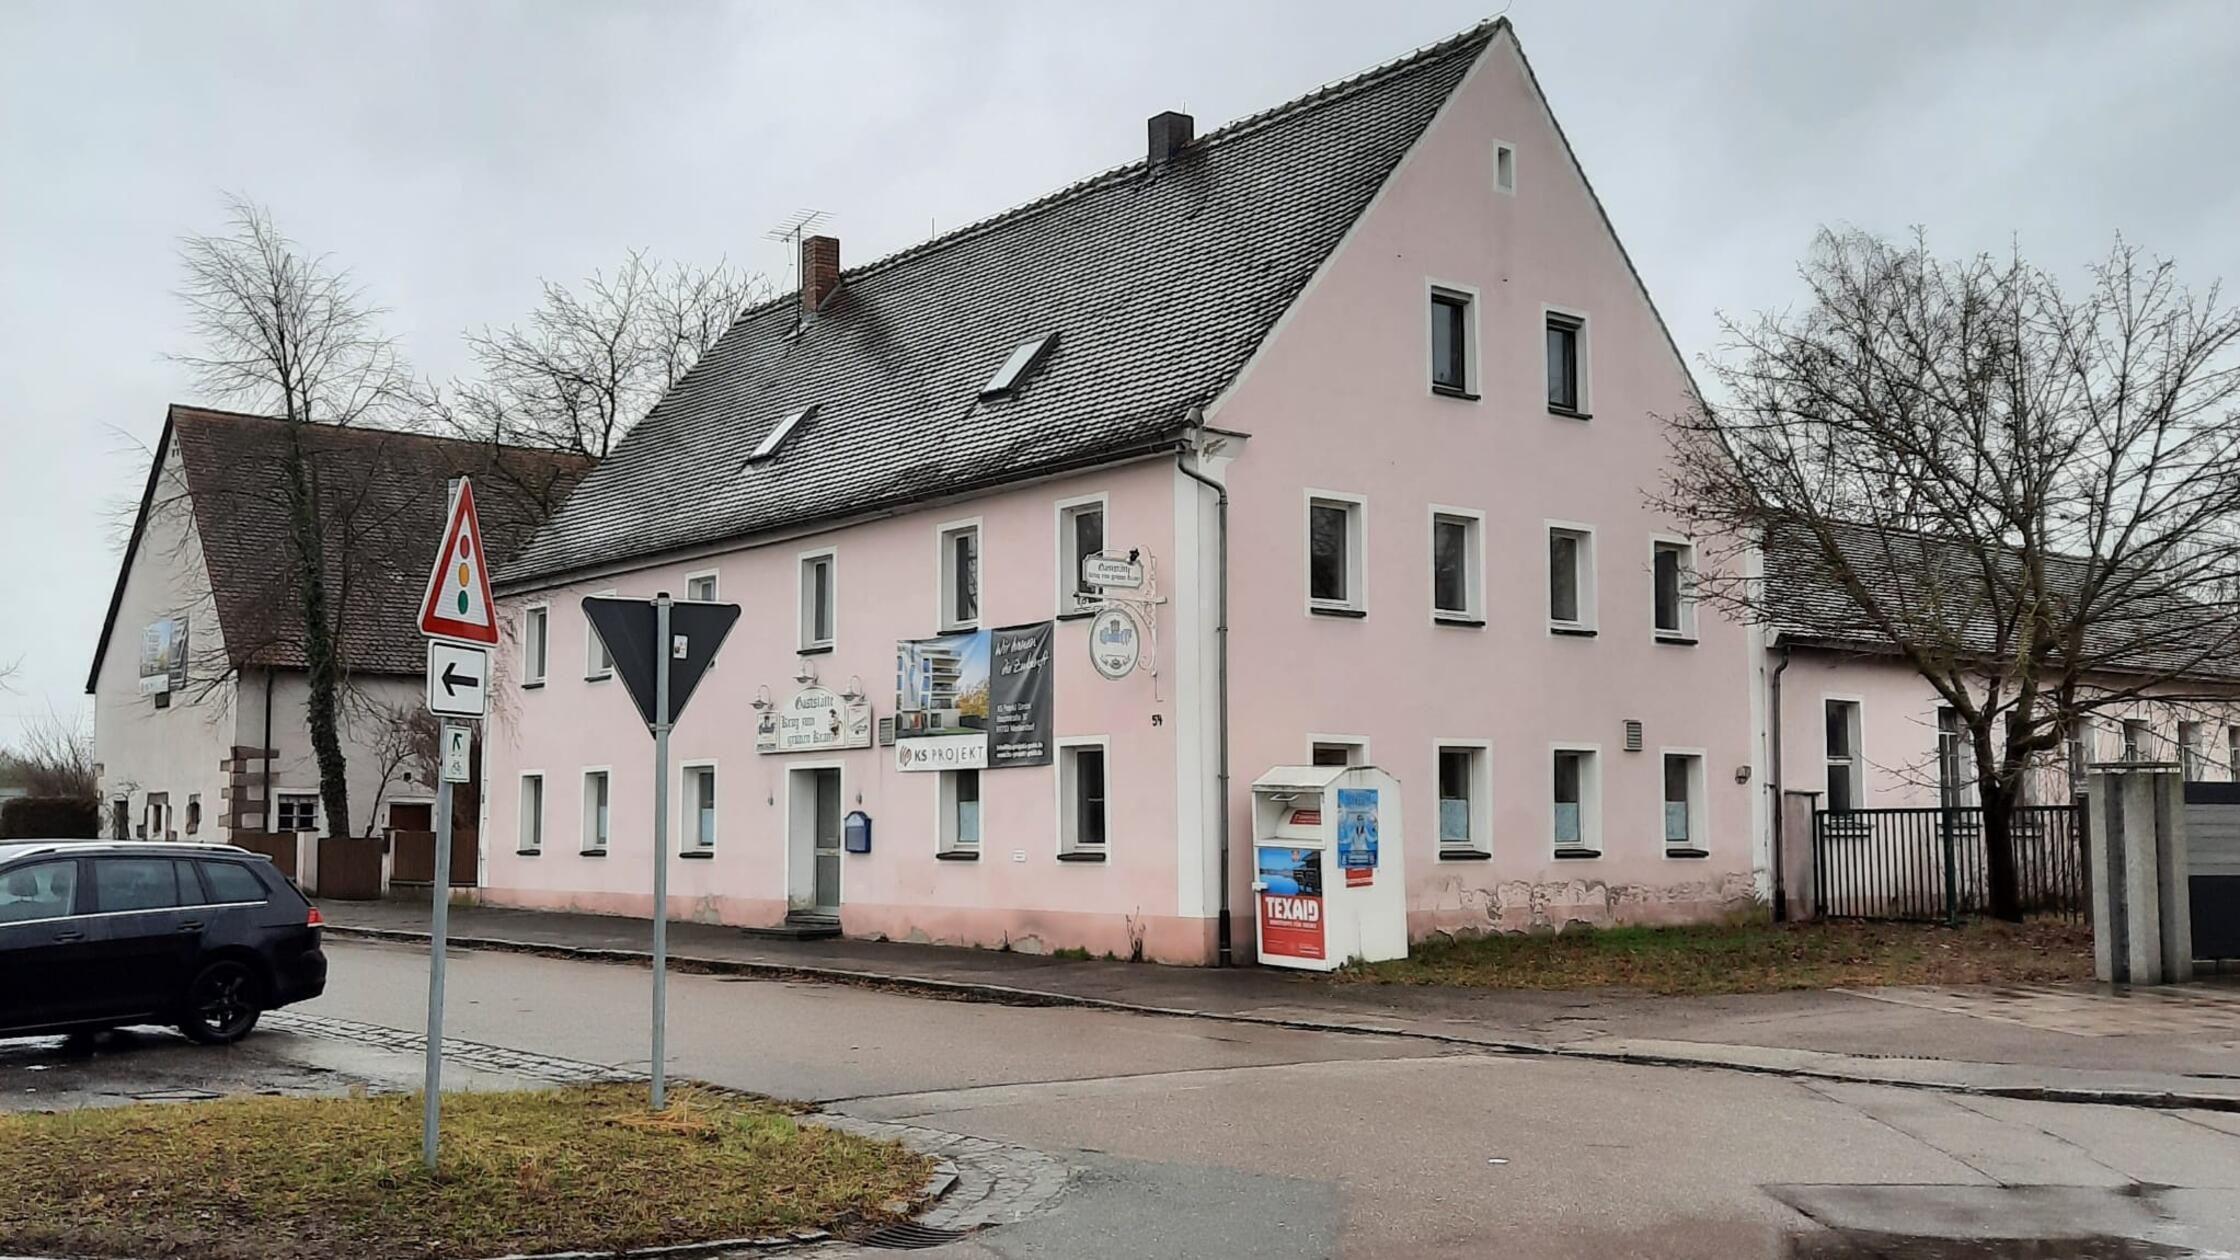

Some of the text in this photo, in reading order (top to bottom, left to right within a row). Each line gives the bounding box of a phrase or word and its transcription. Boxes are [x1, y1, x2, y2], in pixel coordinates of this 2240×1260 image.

[915, 748, 928, 762] KS
[931, 745, 984, 764] PROJEKT
[1265, 896, 1319, 922] TEXAID
